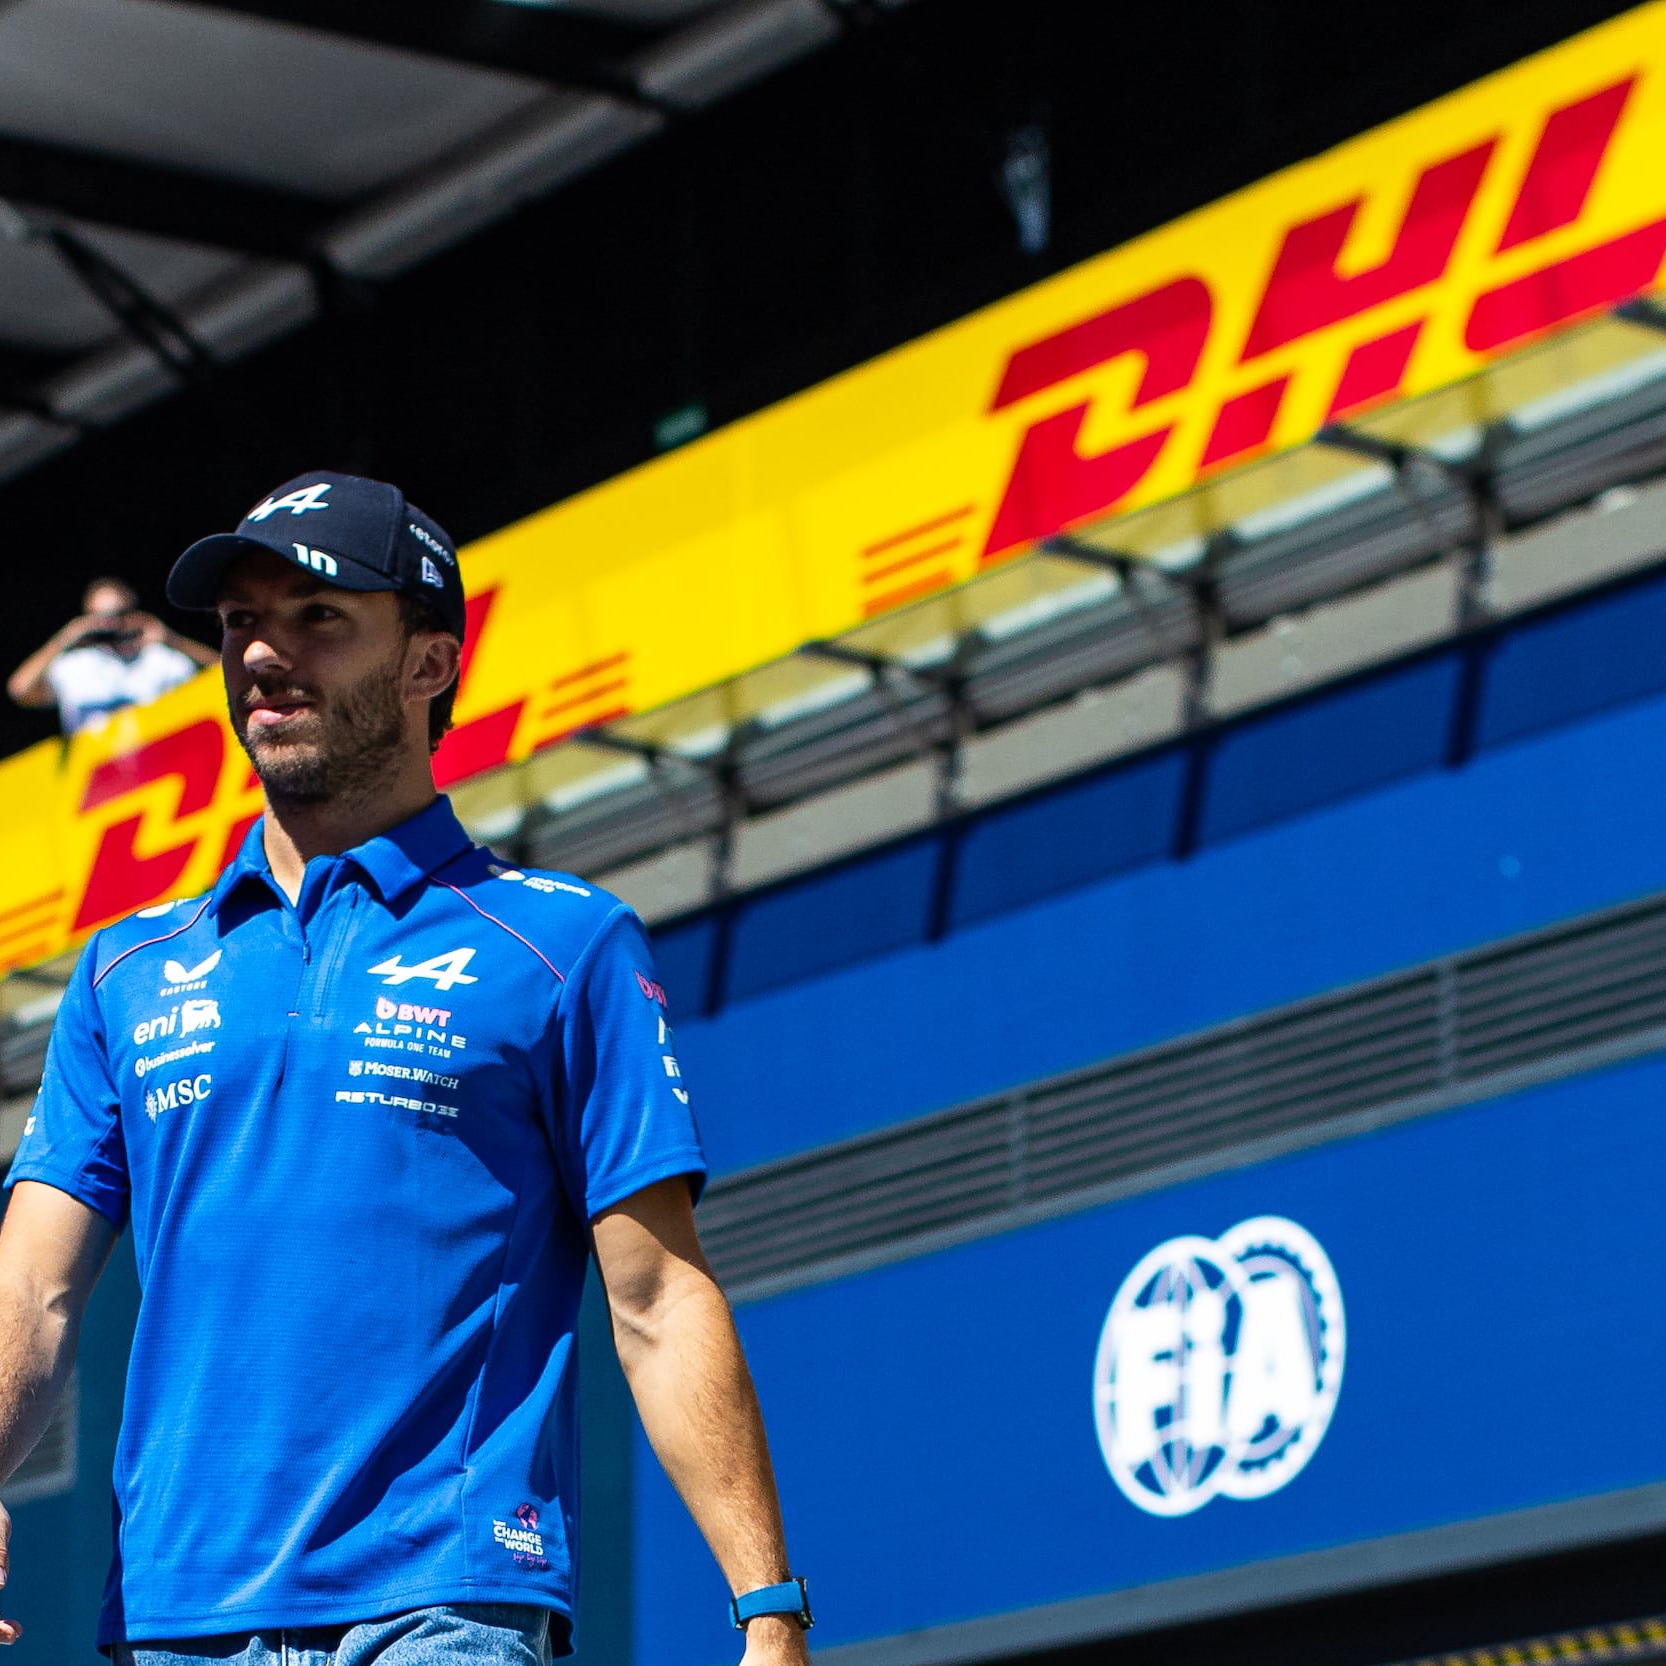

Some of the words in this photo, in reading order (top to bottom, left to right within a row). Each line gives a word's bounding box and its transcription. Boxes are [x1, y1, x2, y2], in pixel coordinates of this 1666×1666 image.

[133, 1006, 180, 1045] eni
[396, 1003, 451, 1027] BWT
[352, 1021, 468, 1049] ALPINE
[364, 1036, 404, 1051] FORMULA
[406, 1039, 424, 1054] ONE
[427, 1044, 451, 1059] TEAM
[155, 1073, 212, 1113] MSC
[494, 1527, 542, 1546] CHANGE
[504, 1538, 545, 1556] WORLD
